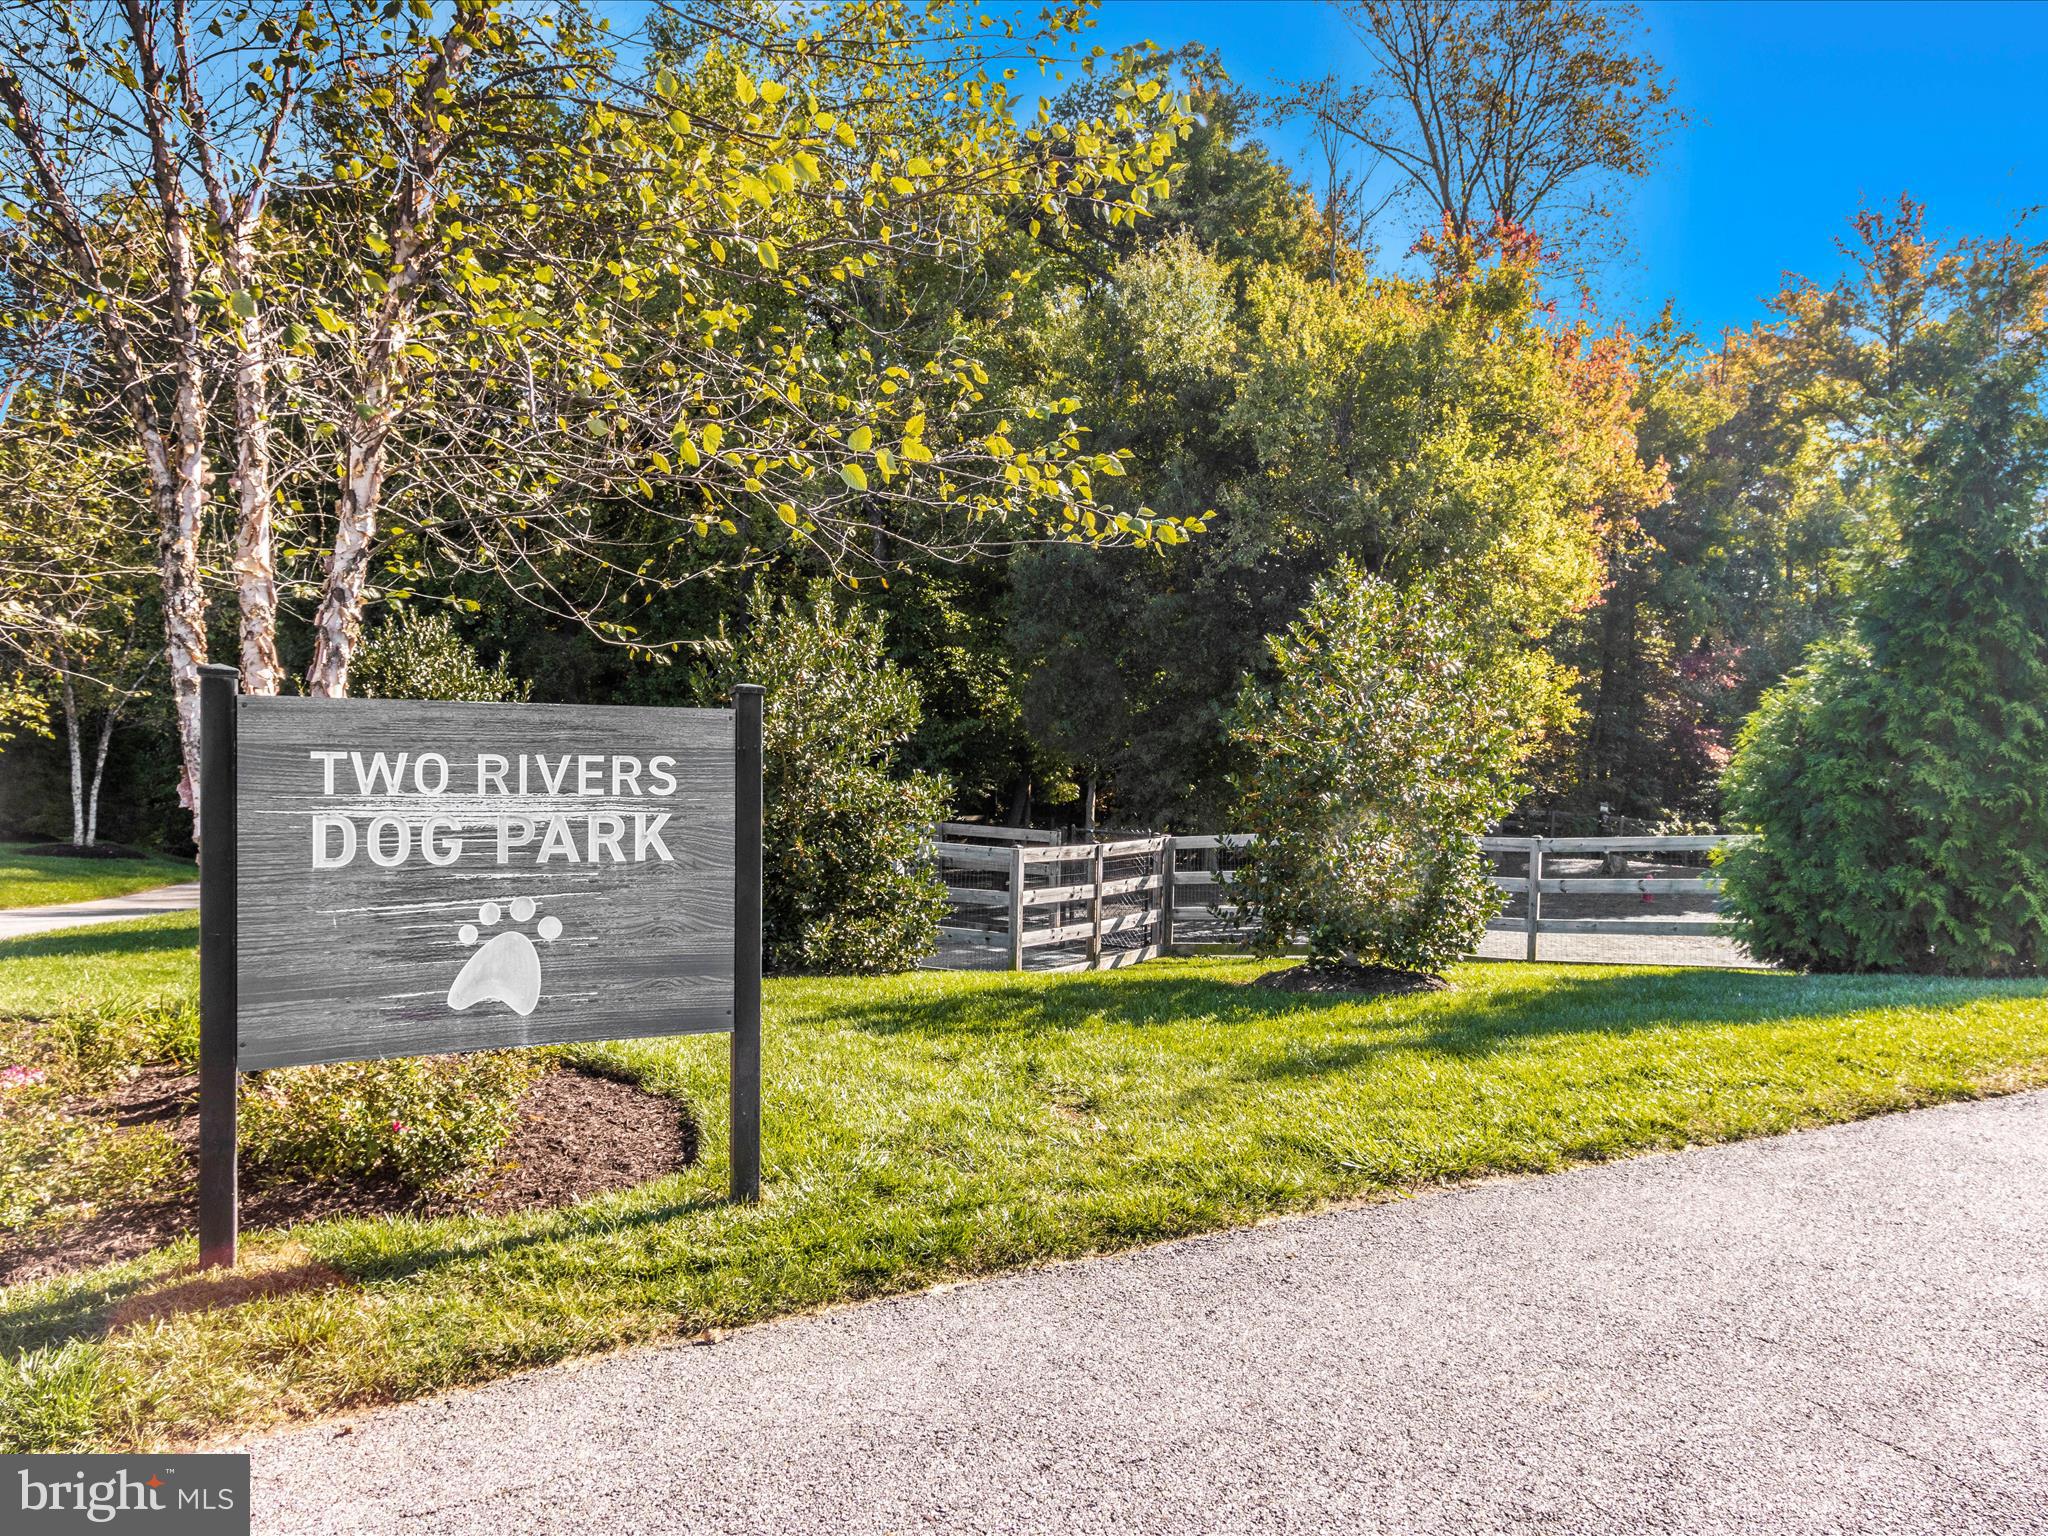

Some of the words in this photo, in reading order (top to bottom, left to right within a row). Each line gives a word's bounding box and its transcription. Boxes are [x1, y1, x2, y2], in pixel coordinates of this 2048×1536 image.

[310, 751, 449, 795] TWO
[477, 753, 678, 796] RIVERS
[311, 814, 463, 869] DOG
[496, 812, 675, 864] PARK
